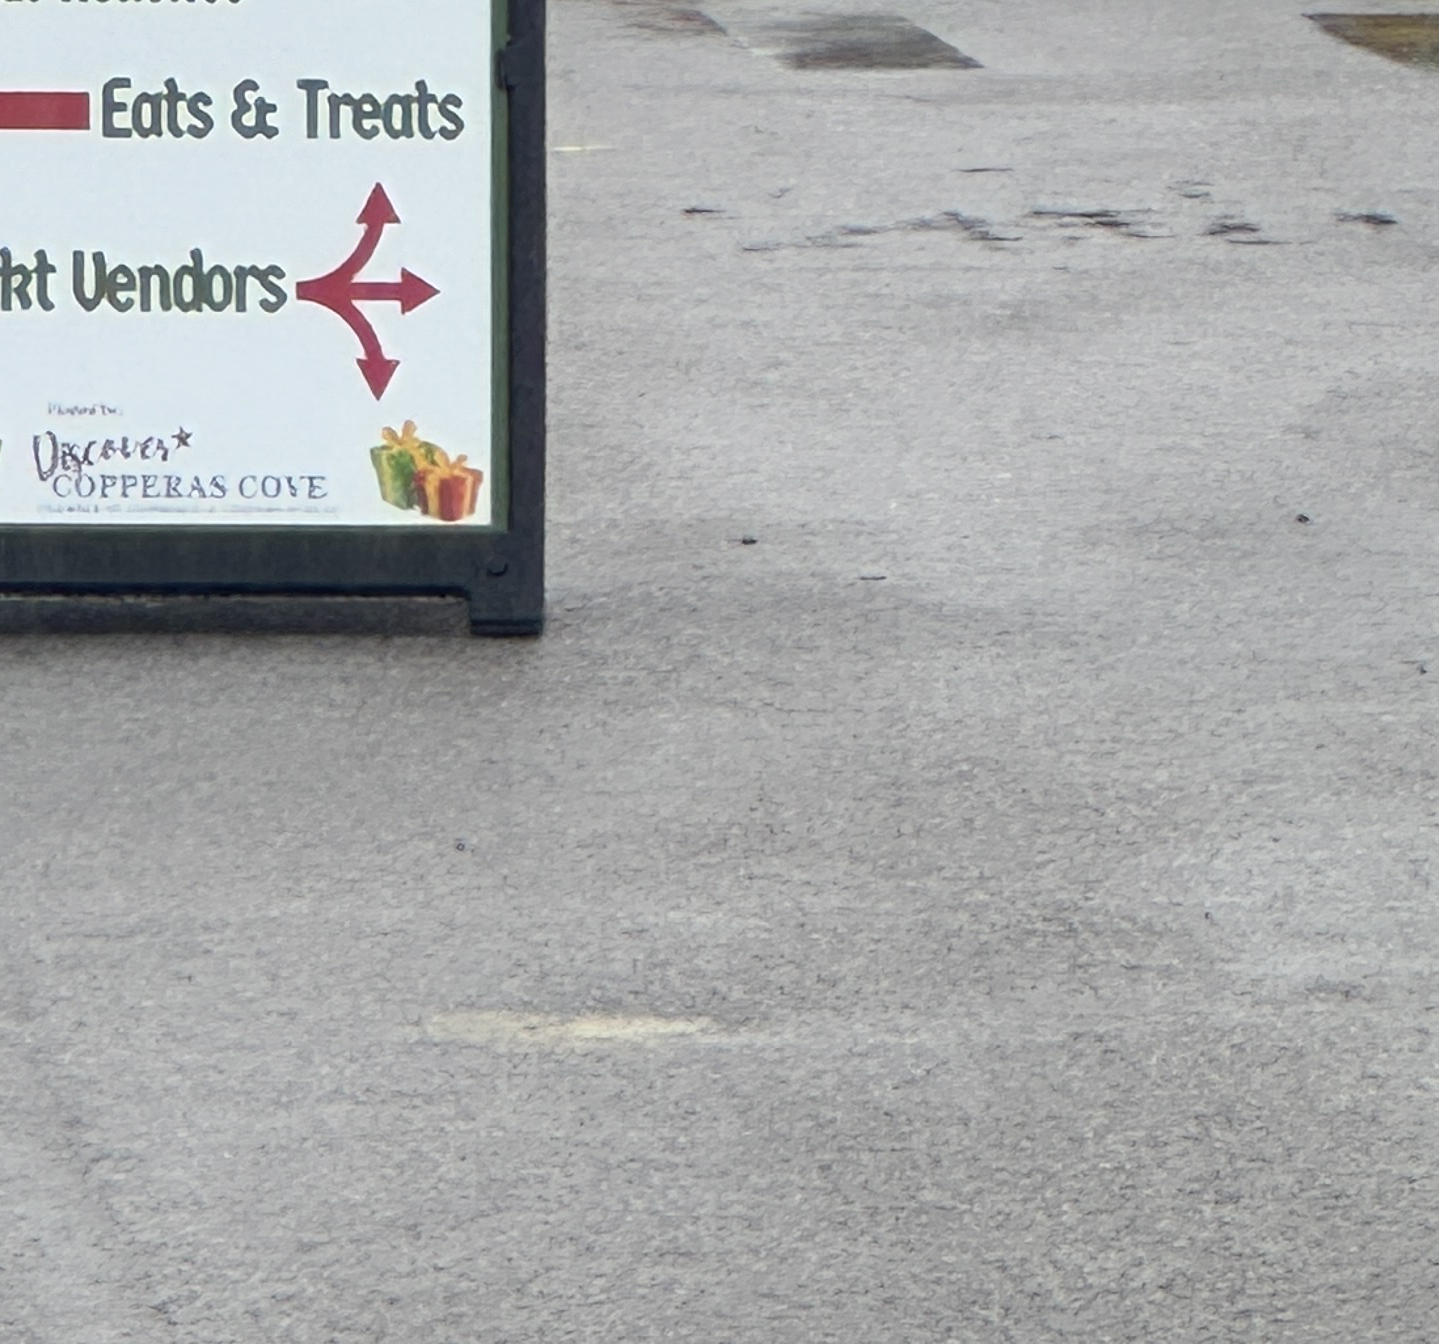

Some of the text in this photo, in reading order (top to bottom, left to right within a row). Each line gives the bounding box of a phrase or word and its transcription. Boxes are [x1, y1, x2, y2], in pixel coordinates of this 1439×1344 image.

[100, 76, 466, 141] Eats & Treats
[72, 246, 289, 314] Vendors
[52, 473, 329, 500] COPPERAS COVE
